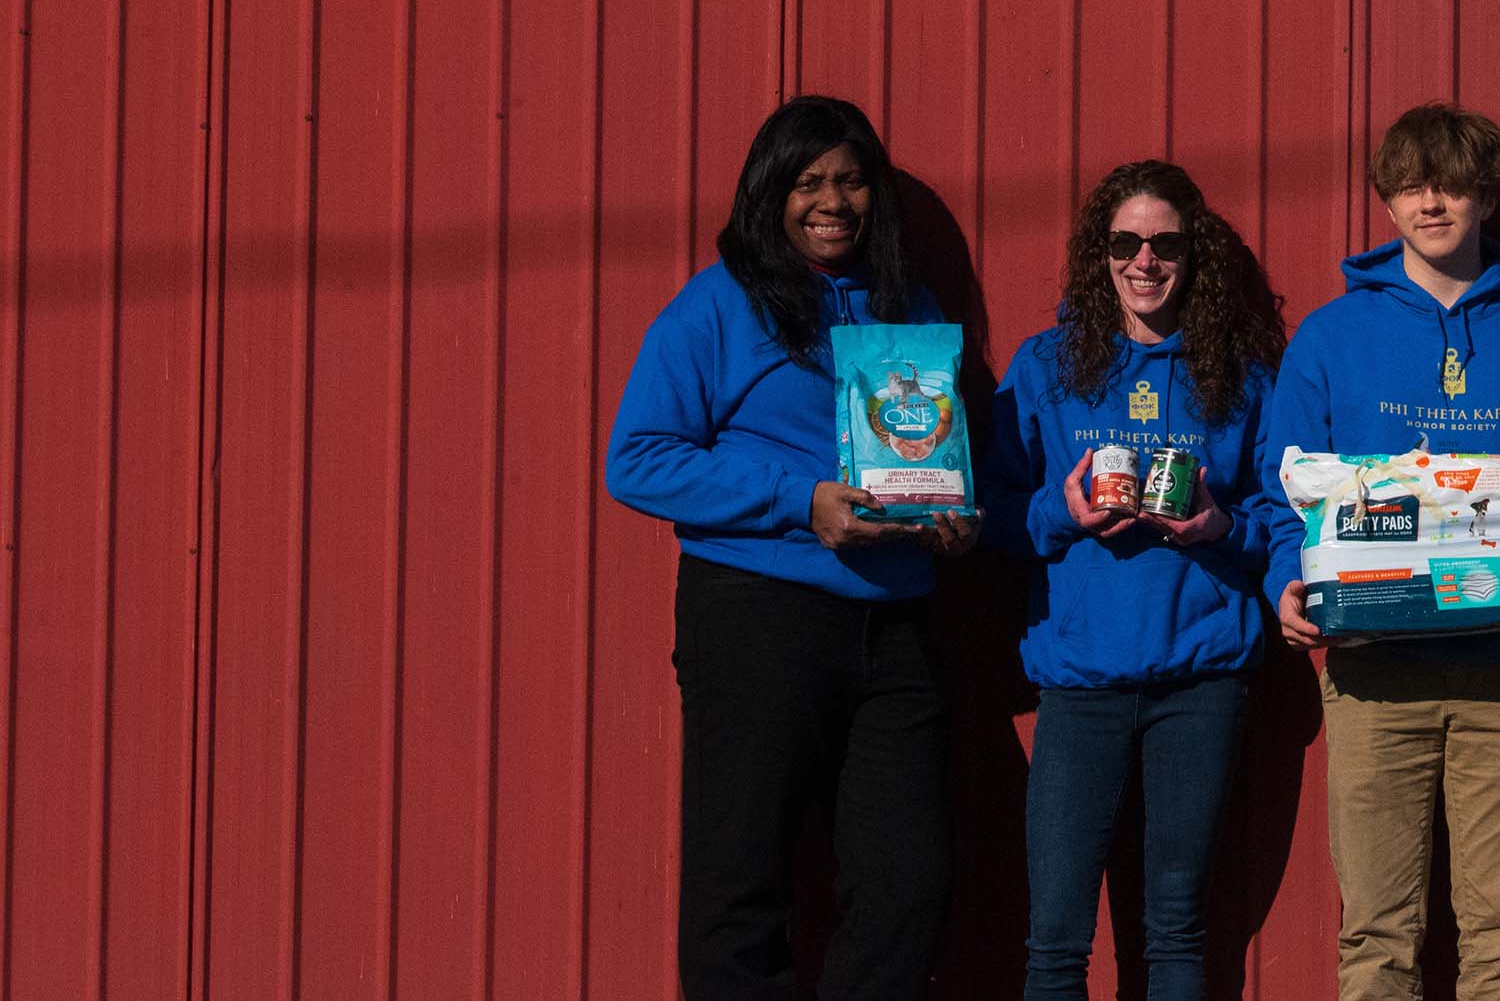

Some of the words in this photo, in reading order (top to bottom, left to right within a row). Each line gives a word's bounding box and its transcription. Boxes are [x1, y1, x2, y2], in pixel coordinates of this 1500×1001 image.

[884, 407, 933, 424] ONE
[1380, 402, 1408, 415] PHI
[1415, 406, 1467, 420] THETA
[1406, 420, 1446, 430] HONOR
[1451, 423, 1497, 431] SOCIETY
[1075, 430, 1099, 441] PHI
[1107, 428, 1160, 444] THETA
[1383, 514, 1413, 531] PADS
